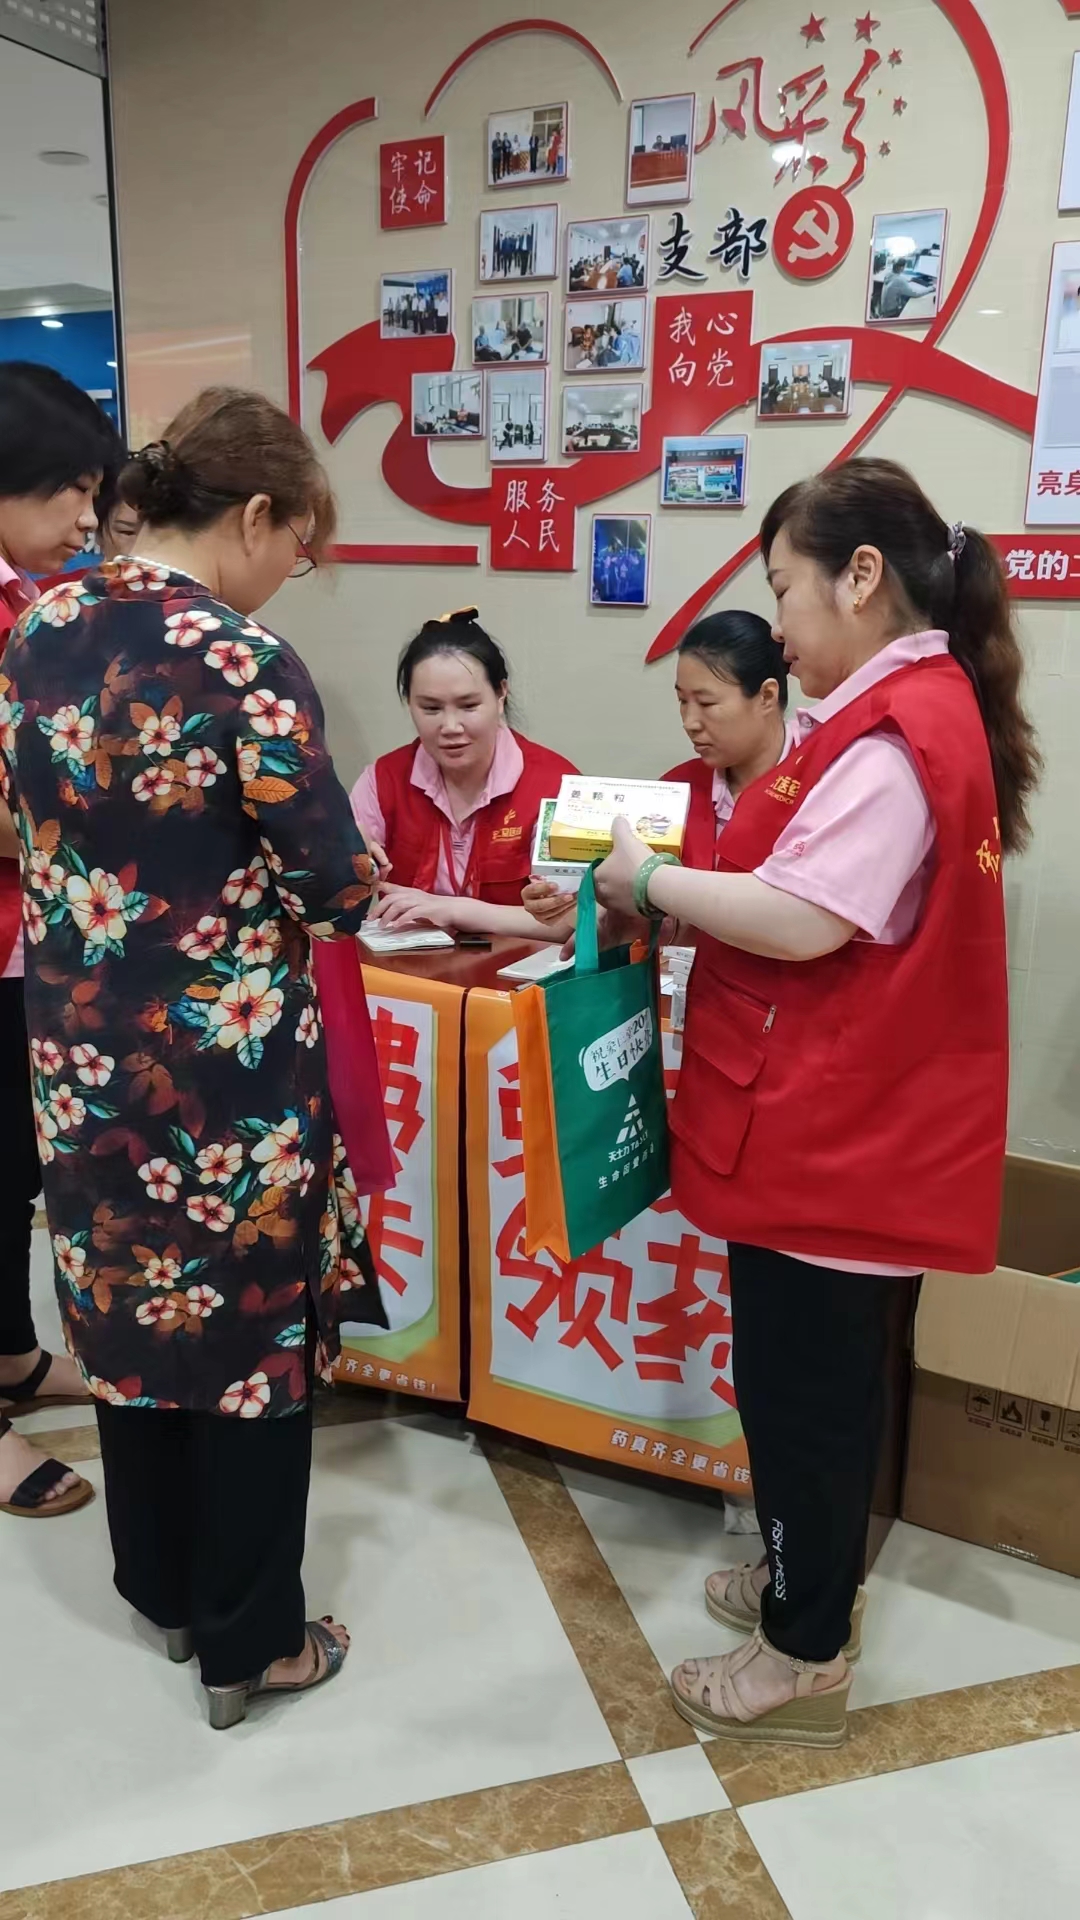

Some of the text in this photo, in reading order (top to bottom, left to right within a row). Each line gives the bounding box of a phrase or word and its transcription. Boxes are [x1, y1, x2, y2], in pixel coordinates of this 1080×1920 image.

[389, 149, 437, 182] 牢记
[389, 179, 438, 216] 使命
[656, 207, 769, 282] 支部
[668, 306, 739, 347] 我心
[668, 353, 735, 388] 向党
[504, 478, 566, 514] 服务
[503, 519, 561, 553] 人民
[771, 1517, 784, 1553] FISH
